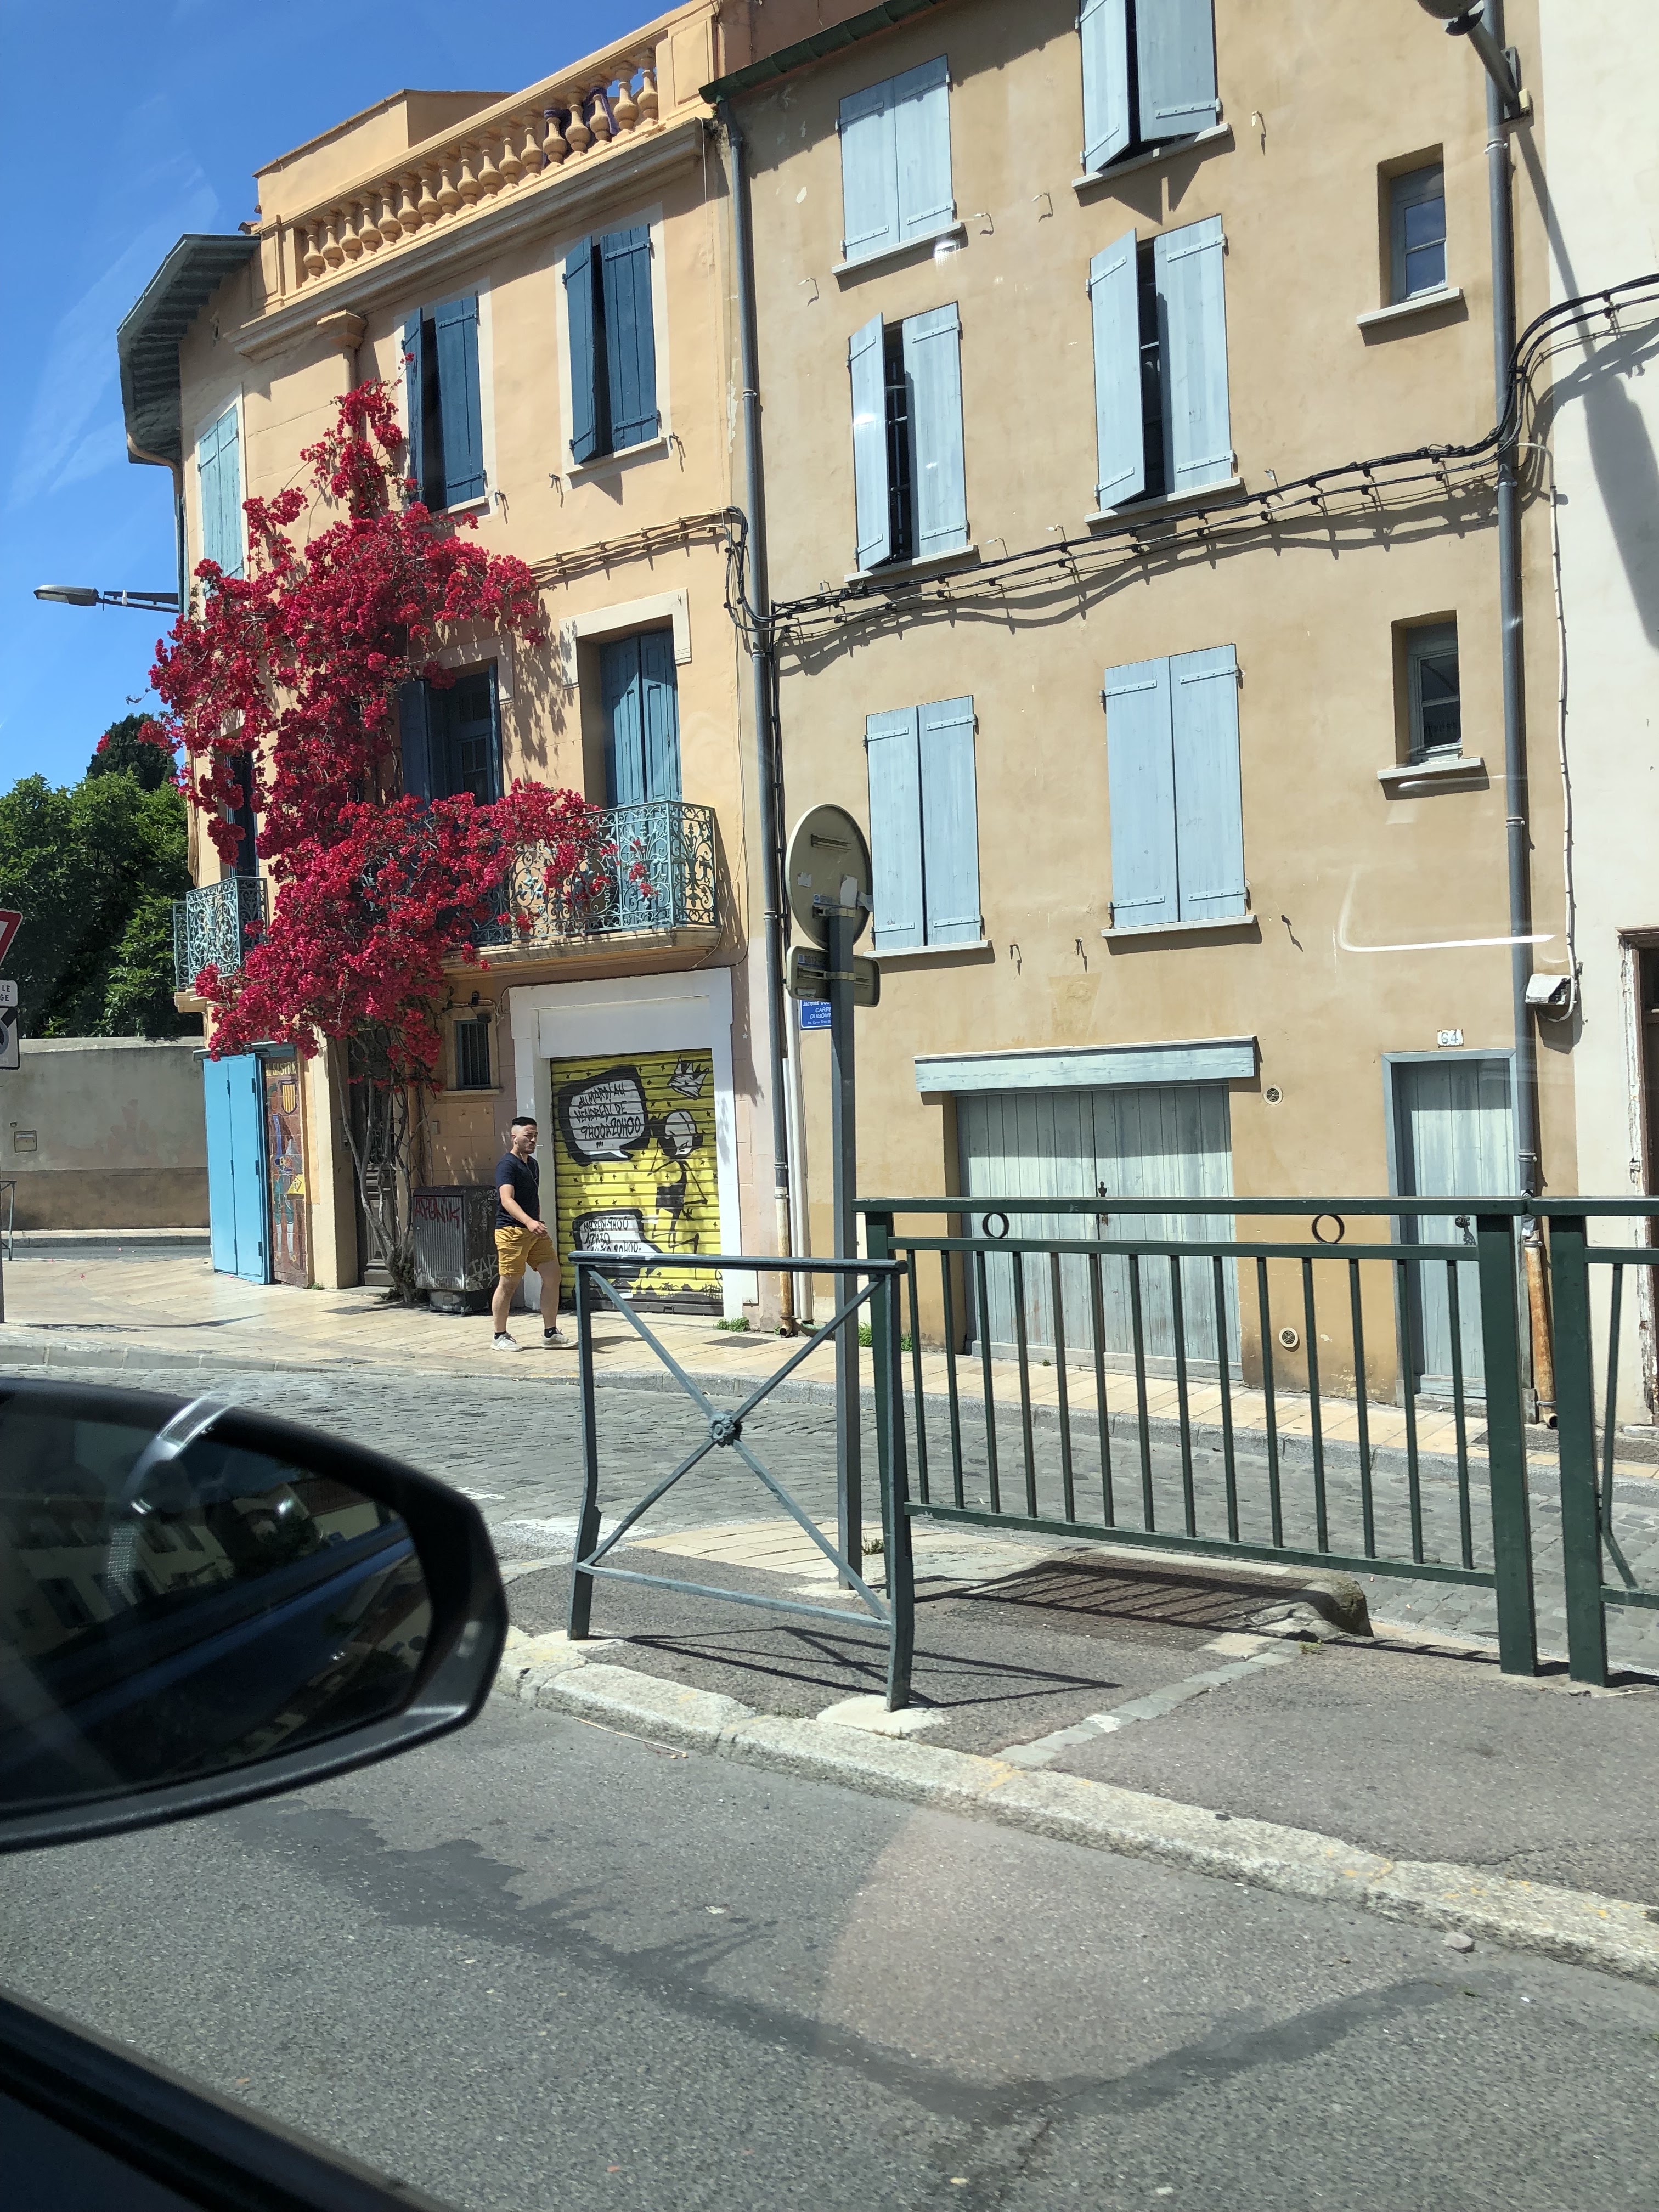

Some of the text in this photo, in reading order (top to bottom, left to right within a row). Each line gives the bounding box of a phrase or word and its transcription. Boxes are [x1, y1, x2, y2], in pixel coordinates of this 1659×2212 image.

[1441, 1029, 1459, 1045] 64
[273, 1061, 297, 1076] SASTRE
[614, 1101, 628, 1115] DE
